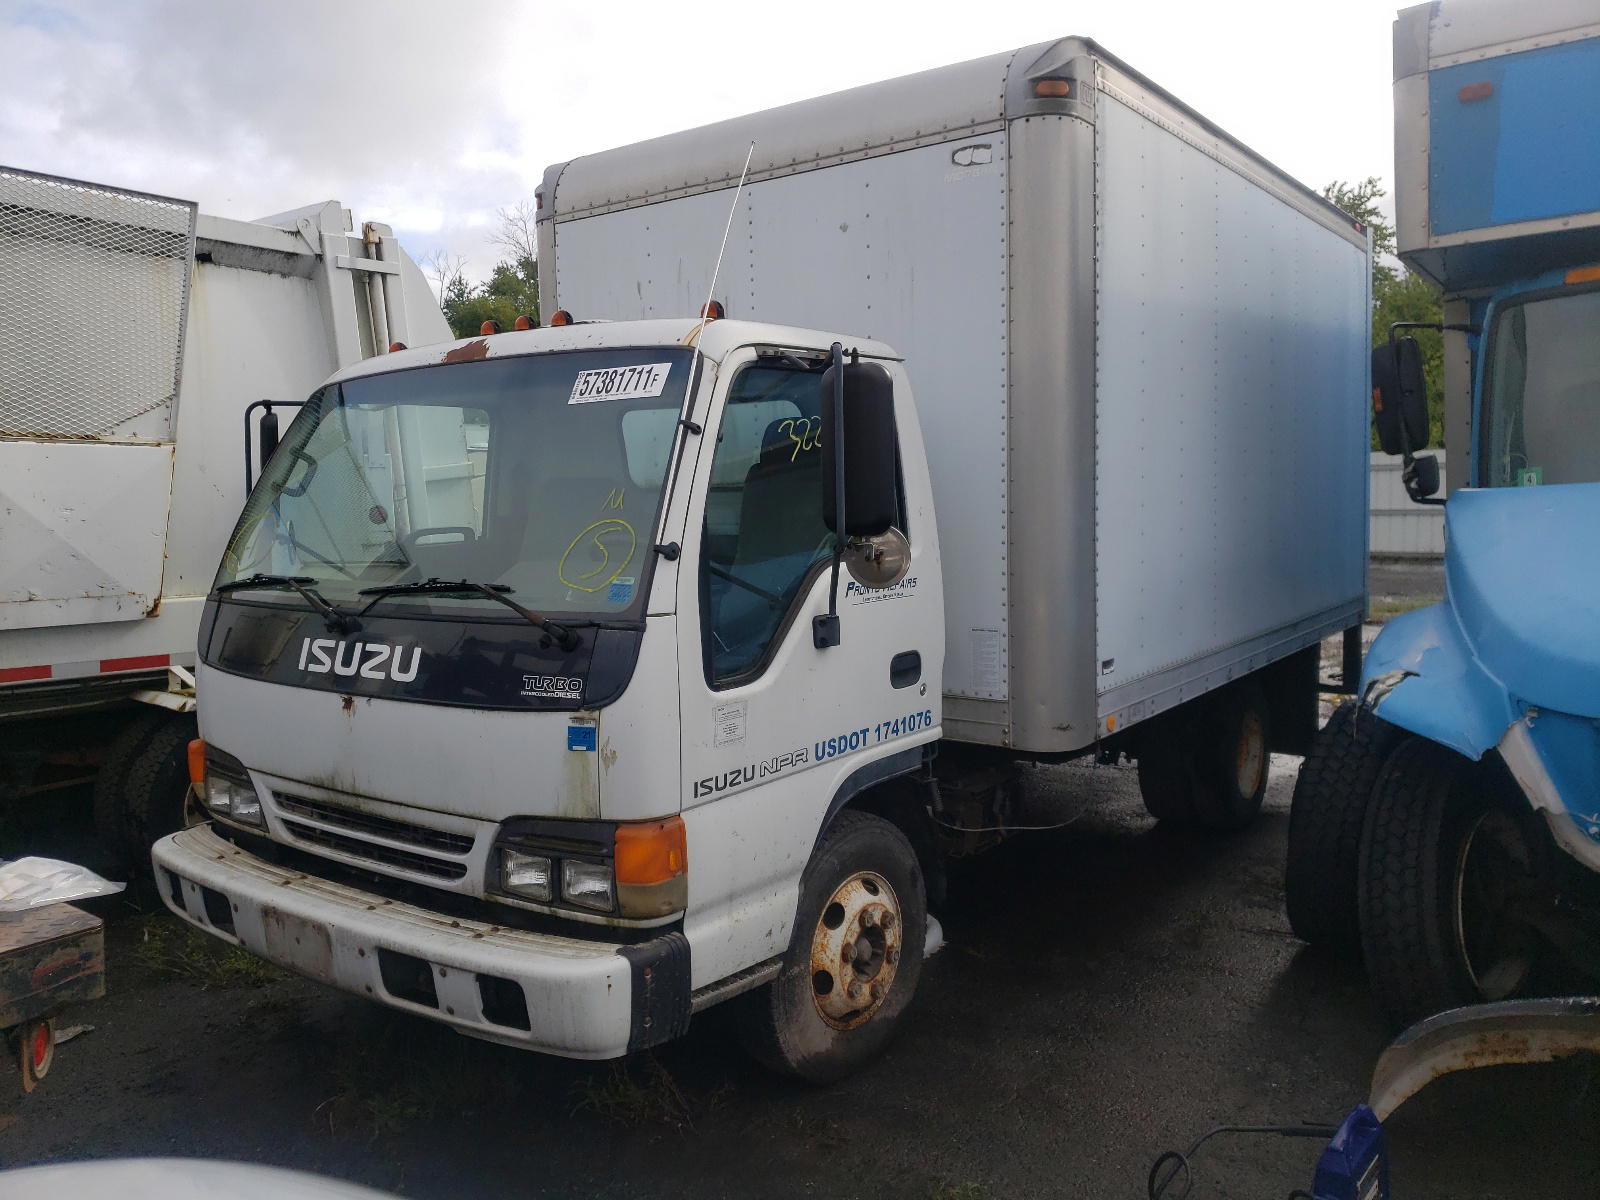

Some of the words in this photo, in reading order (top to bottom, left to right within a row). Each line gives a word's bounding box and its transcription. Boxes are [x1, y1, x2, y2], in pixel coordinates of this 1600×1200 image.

[298, 637, 422, 683] ISUZU
[522, 675, 583, 692] TURBO
[555, 691, 581, 699] DIESEL
[693, 764, 755, 799] ISUZU
[759, 747, 808, 778] NPR
[814, 727, 870, 762] USDOT
[874, 709, 932, 742] 1741076
